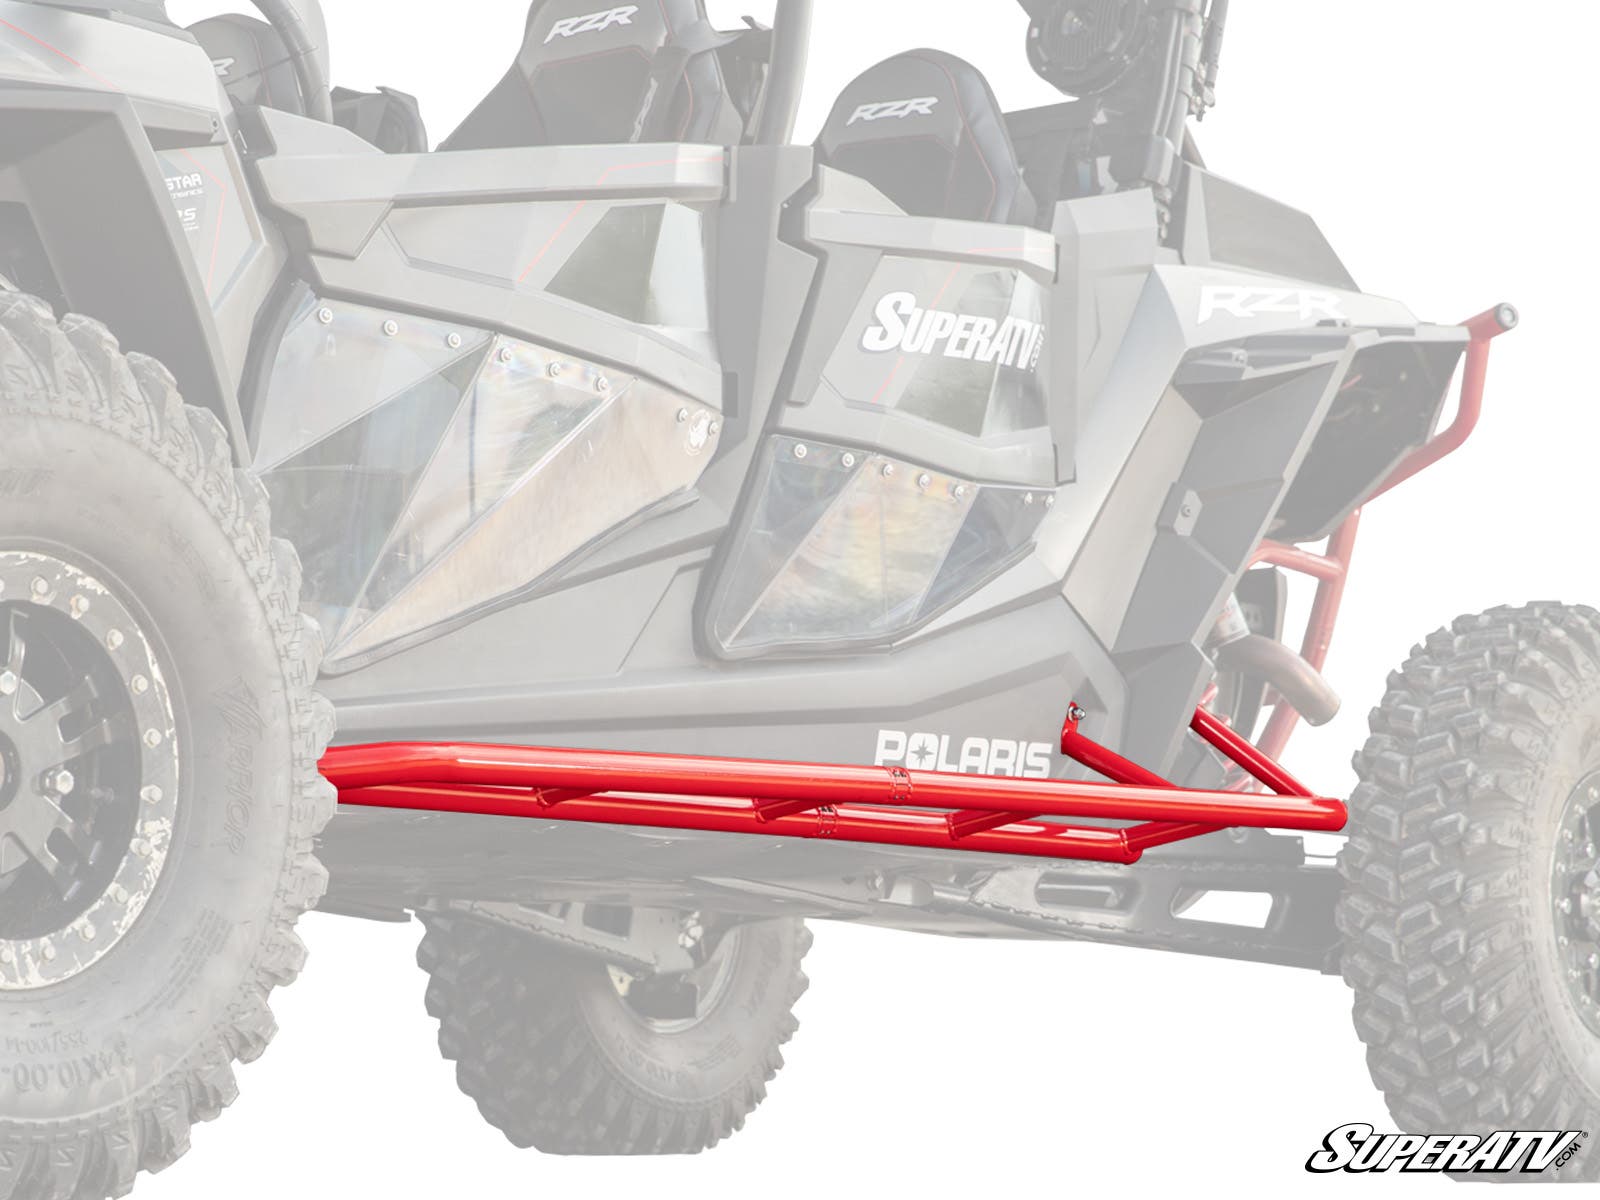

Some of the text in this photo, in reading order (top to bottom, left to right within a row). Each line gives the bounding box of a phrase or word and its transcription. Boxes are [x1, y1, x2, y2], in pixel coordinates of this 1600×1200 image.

[543, 5, 639, 44] RZR
[846, 96, 938, 127] RZR
[1197, 286, 1349, 325] RZR
[874, 729, 1053, 779] POLARIS
